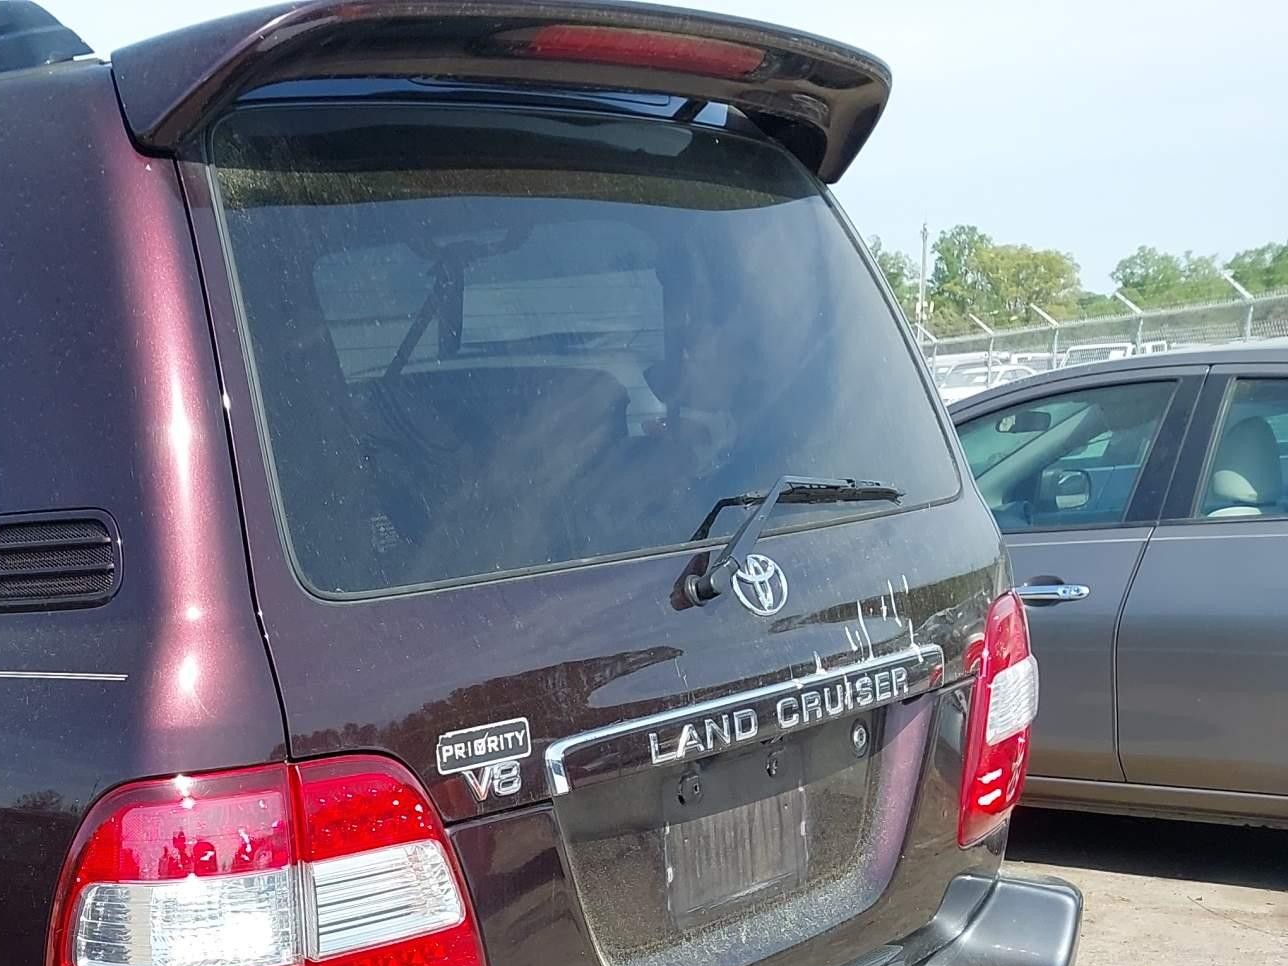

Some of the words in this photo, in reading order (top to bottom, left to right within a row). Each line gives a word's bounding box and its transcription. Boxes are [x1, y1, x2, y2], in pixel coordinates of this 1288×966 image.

[648, 708, 759, 766] LAND
[776, 666, 910, 730] CRUISER
[442, 729, 526, 763] PRIORITY
[463, 760, 522, 801] V8
